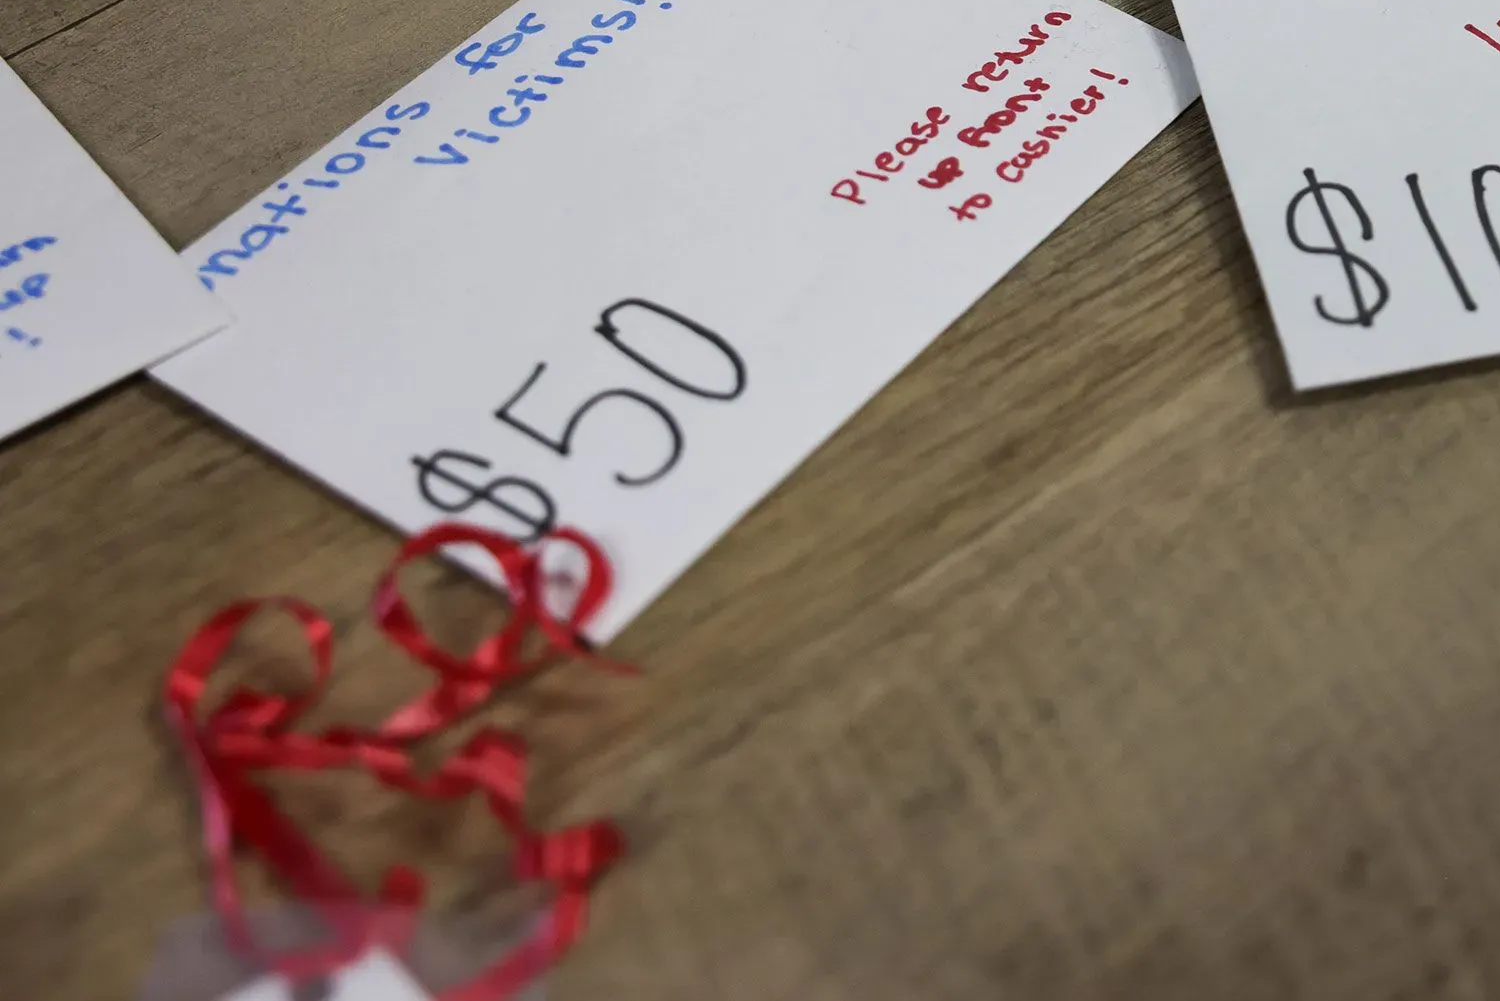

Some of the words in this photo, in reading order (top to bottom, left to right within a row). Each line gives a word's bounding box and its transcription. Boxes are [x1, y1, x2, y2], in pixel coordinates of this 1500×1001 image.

[197, 101, 430, 291] nations
[455, 12, 546, 75] for
[831, 106, 950, 205] Please
[961, 12, 1072, 92] return
[917, 156, 964, 190] up
[957, 77, 1050, 147] front
[949, 193, 992, 221] to
[996, 68, 1129, 183] cashier!
[411, 297, 747, 547] $50
